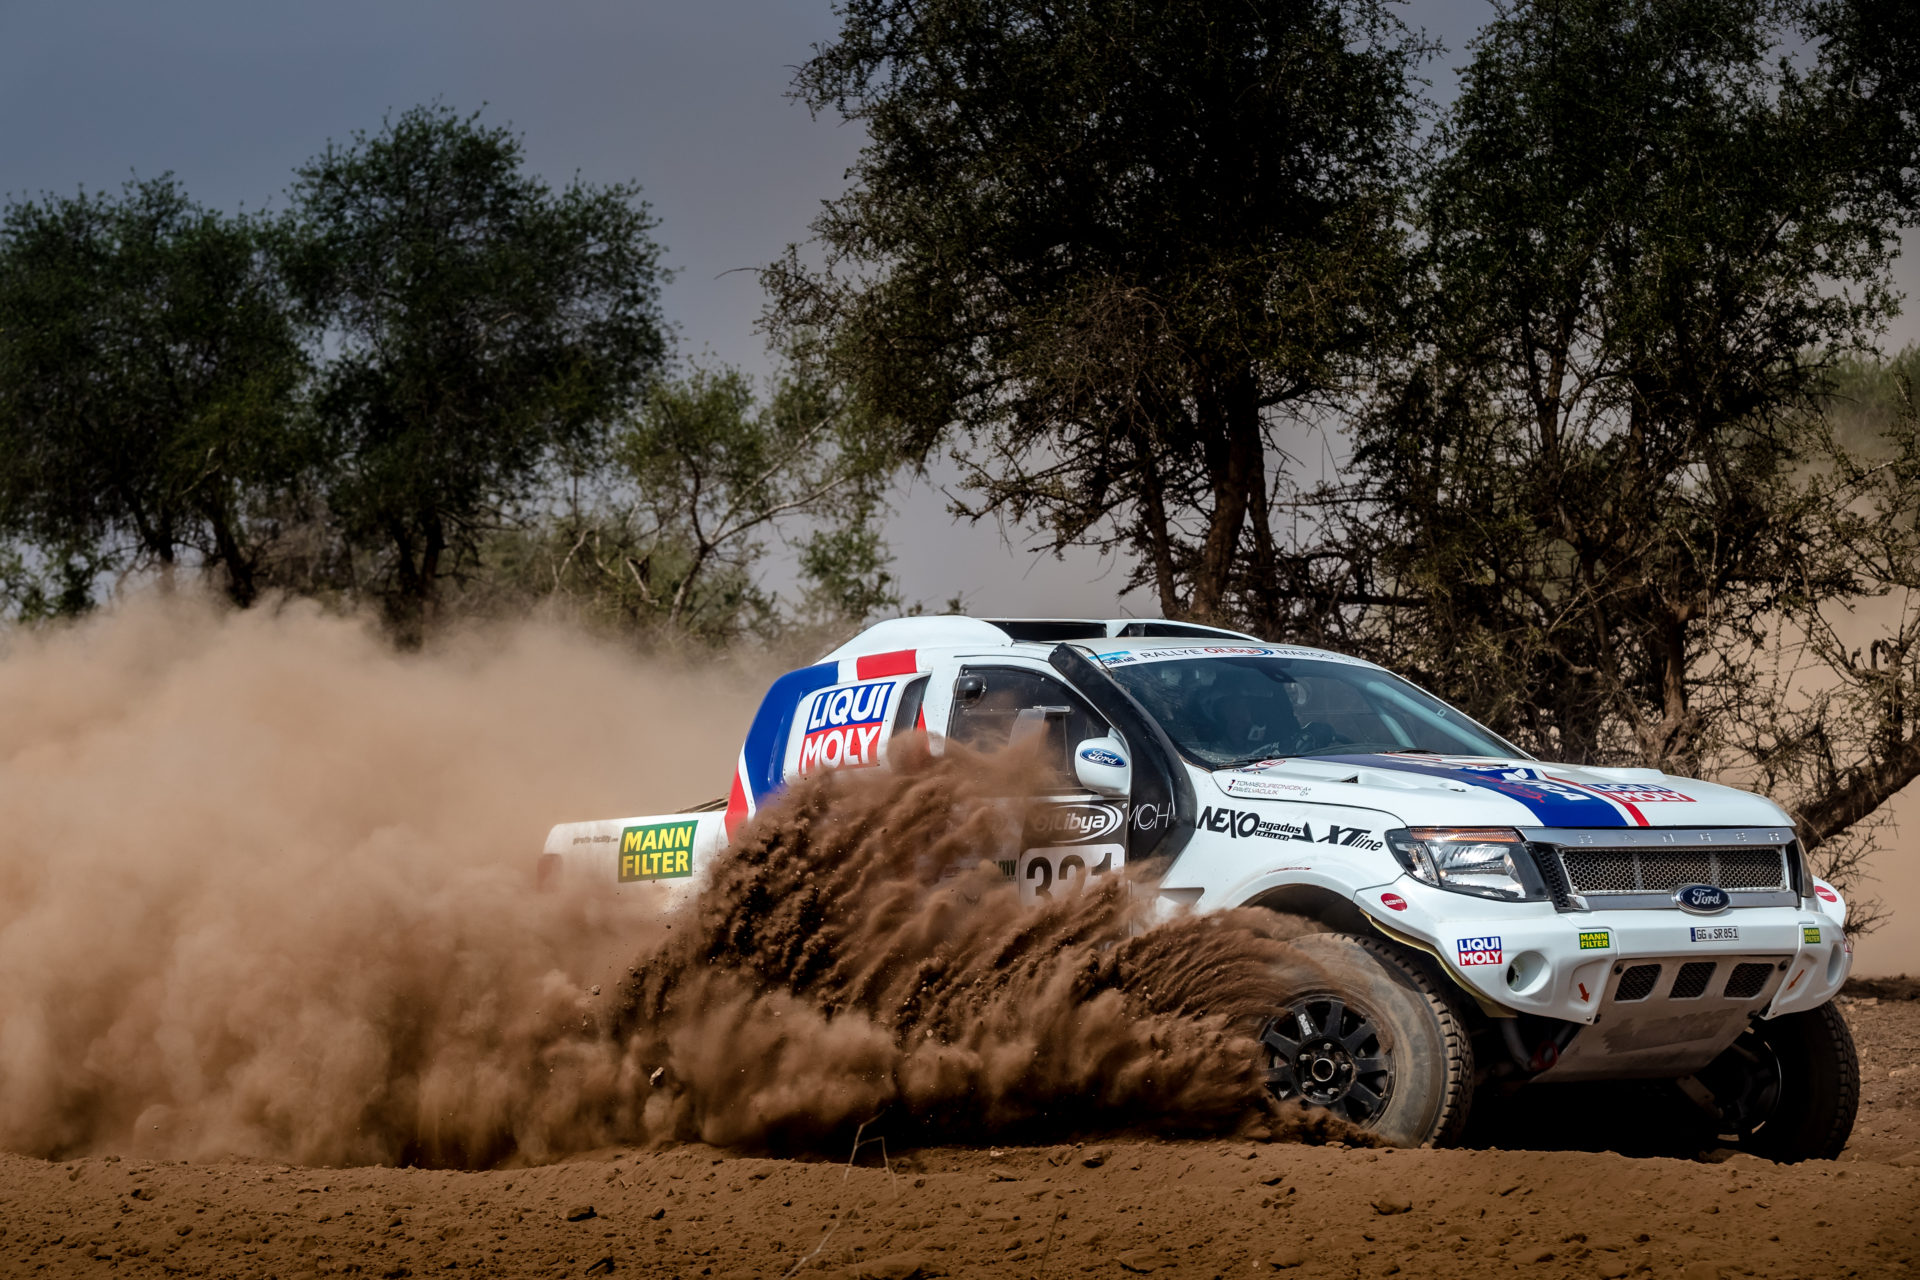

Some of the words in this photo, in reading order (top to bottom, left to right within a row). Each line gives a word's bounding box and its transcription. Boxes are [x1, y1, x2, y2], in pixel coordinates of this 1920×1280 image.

[1140, 648, 1203, 658] RALLYE
[808, 684, 892, 731] LIQUI
[801, 726, 881, 775] MOLY
[1088, 750, 1119, 765] Ford
[1587, 784, 1670, 792] LIQUI
[1609, 791, 1688, 801] MOLY
[1197, 805, 1260, 839] NEXO
[1259, 821, 1303, 835] agados
[623, 826, 693, 853] MANN
[621, 850, 689, 877] FILTER
[1691, 888, 1722, 905] Ford
[1580, 932, 1608, 941] MANN
[1696, 929, 1706, 940] GG
[1459, 937, 1500, 952] LIQUI
[1580, 940, 1609, 949] FILTER
[1460, 951, 1502, 966] MOLY
